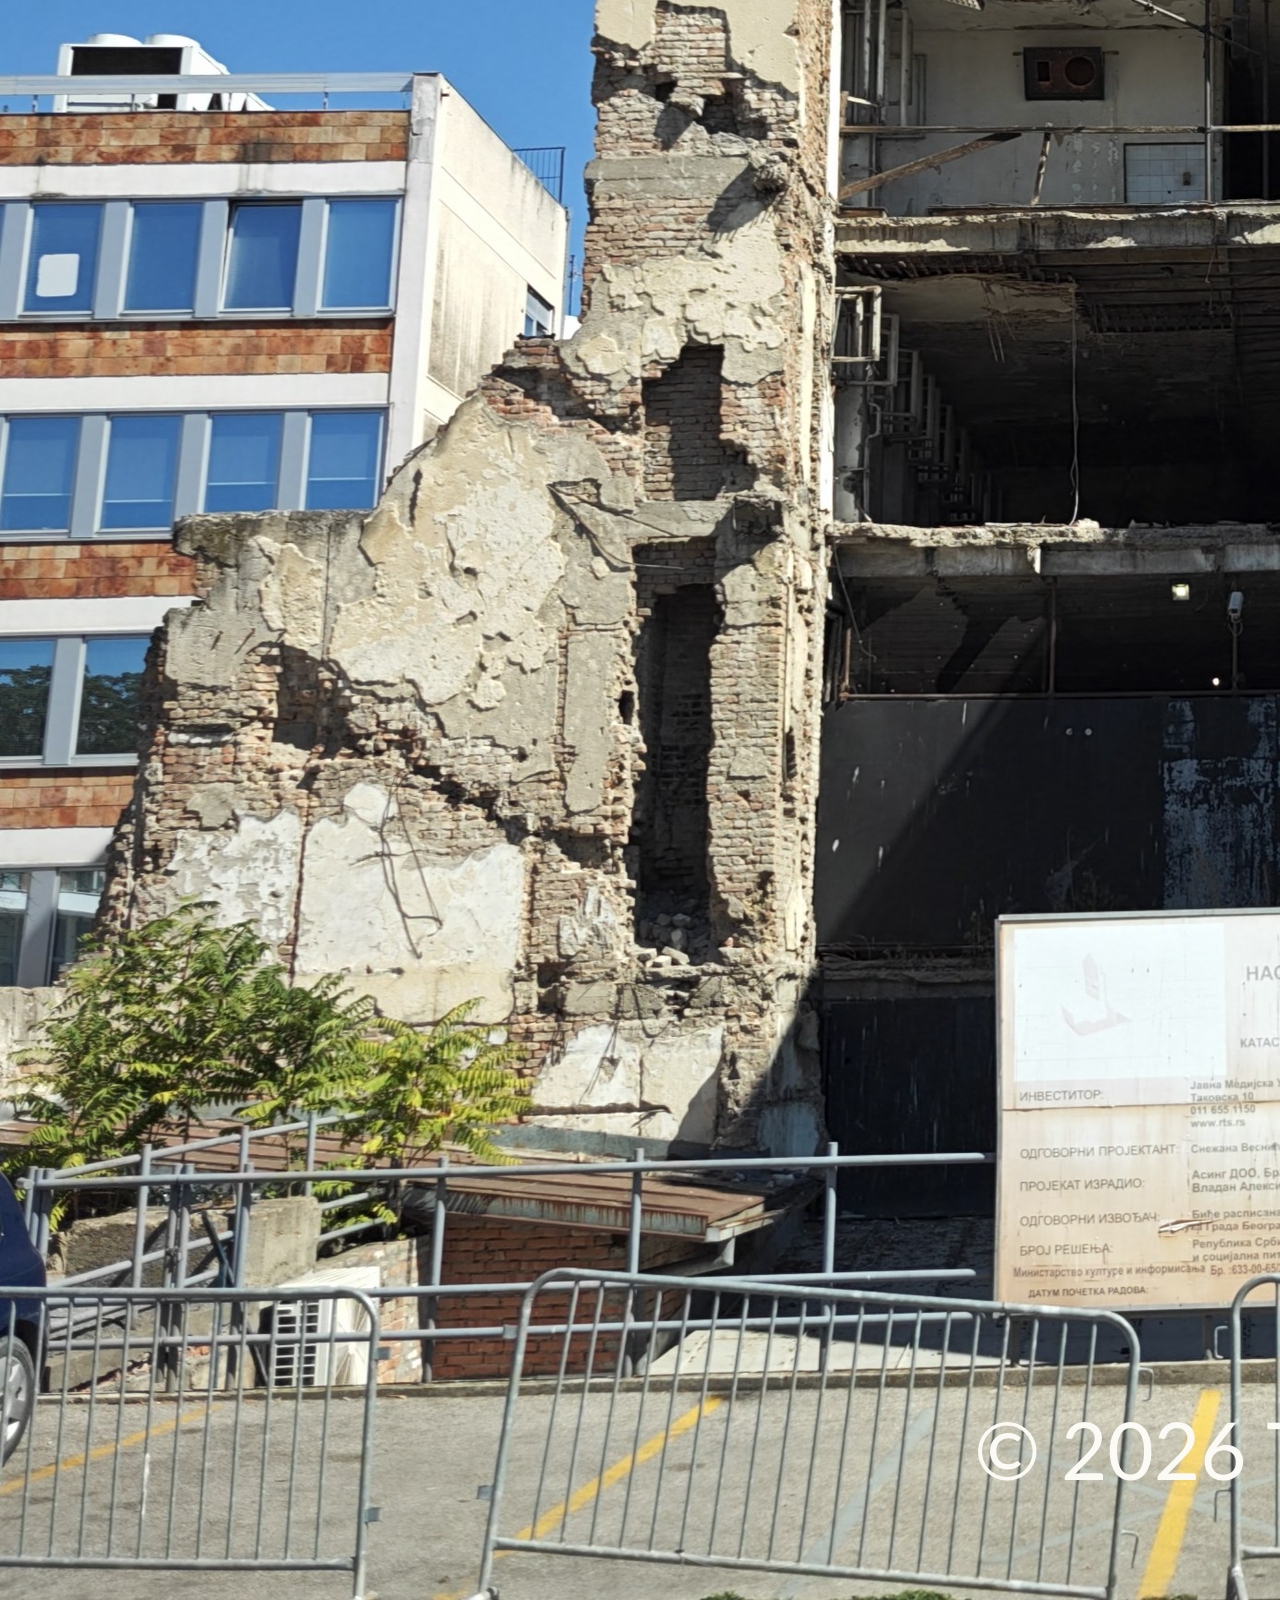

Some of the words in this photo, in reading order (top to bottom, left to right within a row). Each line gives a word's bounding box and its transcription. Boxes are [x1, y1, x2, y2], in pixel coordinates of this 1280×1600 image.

[1190, 1081, 1222, 1090] Јавна
[1225, 1079, 1274, 1090] Медијска
[1020, 1090, 1104, 1101] ИНВЕСТИТОР:
[1191, 1093, 1239, 1102] Таковска
[1242, 1092, 1254, 1100] 10
[1190, 1106, 1207, 1115] 011
[1211, 1105, 1229, 1114] 655
[1233, 1104, 1256, 1113] 1150
[1191, 1118, 1246, 1128] www.rts.rs
[1020, 1148, 1094, 1160] ОДГОВОРНИ
[1099, 1144, 1179, 1156] ПРОЈЕКТАНТ:
[1191, 1144, 1238, 1154] Снежана
[1192, 1170, 1227, 1180] Асинг
[1020, 1180, 1081, 1191] ПРОЈЕКАТ
[1085, 1178, 1145, 1190] ИЗРАДИО:
[1192, 1183, 1236, 1194] Владан
[1020, 1214, 1095, 1227] ОДГОВОРНИ
[1099, 1212, 1160, 1224] ИЗВОЂАЧ:
[1192, 1209, 1220, 1219] Биће
[1020, 1245, 1052, 1256] БРОЈ
[1055, 1243, 1113, 1255] РЕШЕЊА:
[1193, 1239, 1251, 1250] Република
[1202, 1252, 1259, 1263] социјална
[1013, 1267, 1083, 1278] Министарство
[1085, 1267, 1123, 1279] културе
[1126, 1267, 1132, 1275] и
[1135, 1264, 1205, 1276] информисања
[1028, 1288, 1060, 1298] ДАТУМ
[1062, 1286, 1105, 1297] ПОЧЕТКА
